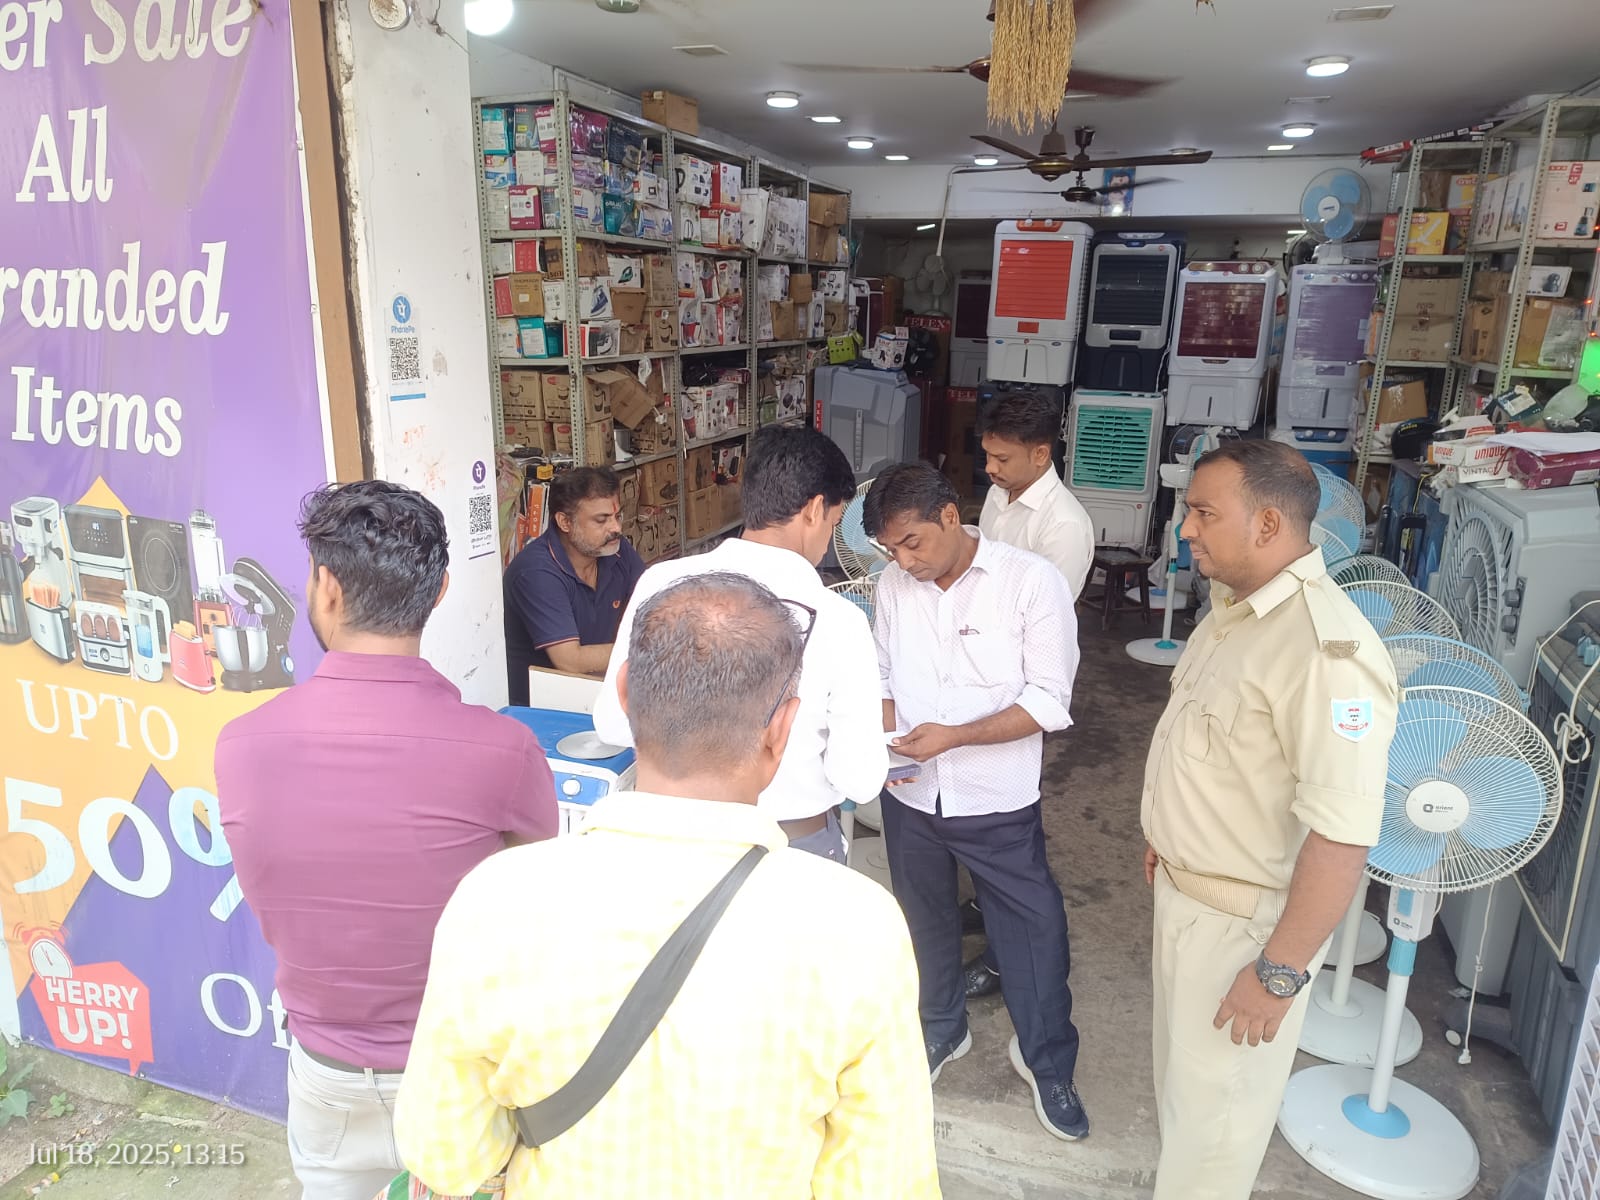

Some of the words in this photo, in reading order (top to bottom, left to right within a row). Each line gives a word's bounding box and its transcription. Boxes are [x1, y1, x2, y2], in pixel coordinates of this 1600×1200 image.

[84, 0, 253, 65] Sale
[15, 105, 114, 203] All
[11, 366, 183, 457] Items
[15, 679, 179, 761] UPTO
[45, 976, 139, 1011] HERRY
[56, 1006, 133, 1050] UP!
